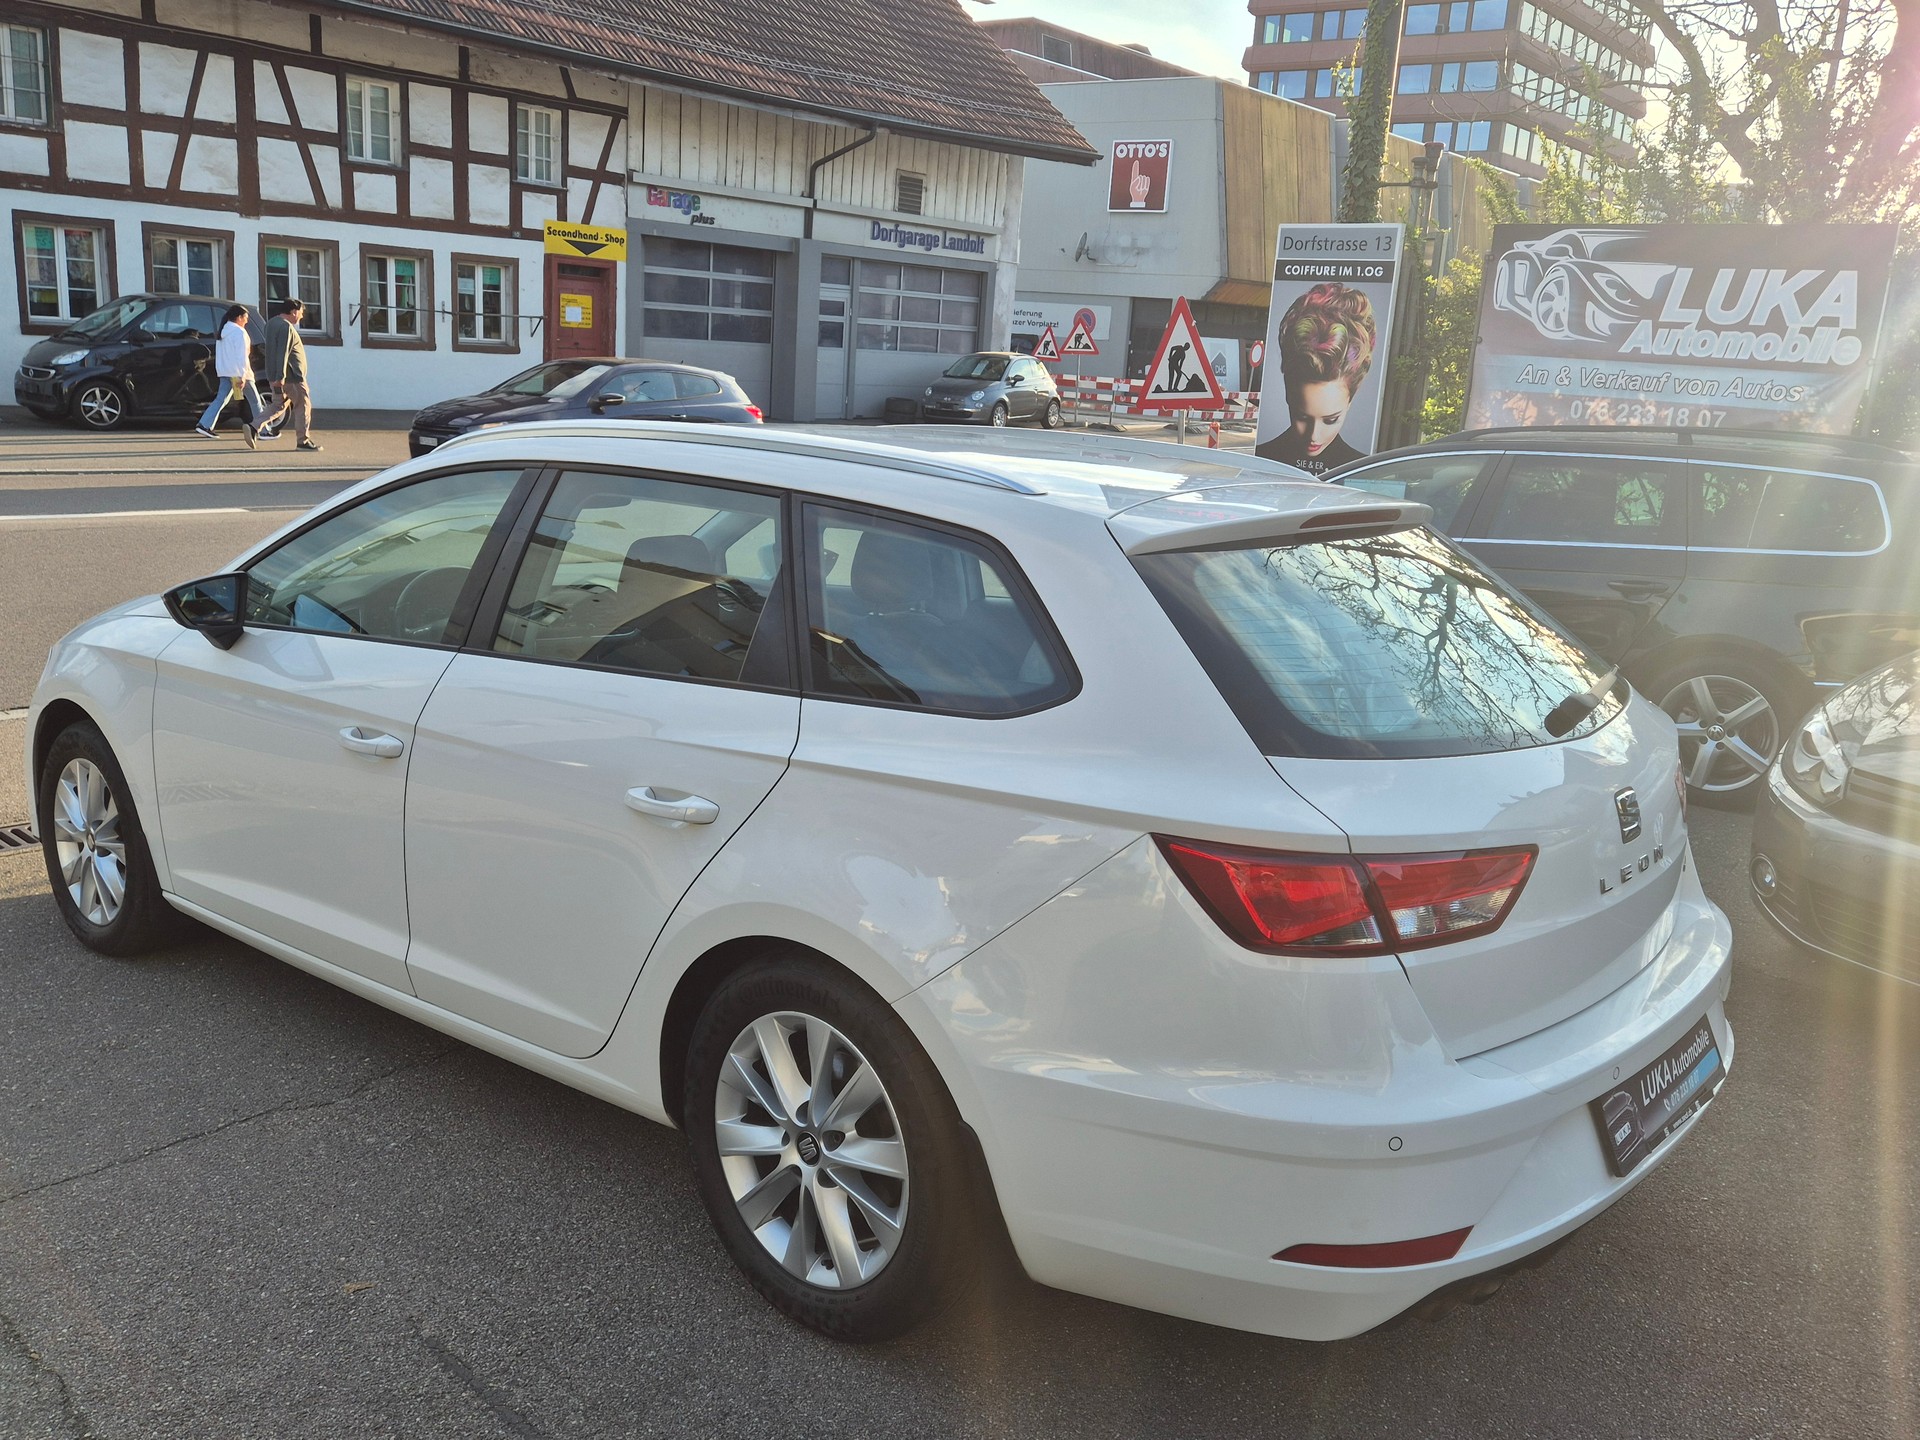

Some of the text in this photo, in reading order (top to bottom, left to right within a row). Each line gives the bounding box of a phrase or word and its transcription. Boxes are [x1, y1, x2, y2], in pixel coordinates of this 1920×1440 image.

[1115, 143, 1168, 158] OTTO'S
[646, 185, 701, 215] Garage
[690, 212, 715, 225] plus
[547, 226, 599, 241] Secondhand
[604, 233, 625, 247] Shop
[870, 220, 985, 254] Dorfgarage Landolt
[1283, 235, 1393, 251] Dorfstrasse 13
[1285, 265, 1384, 277] COIFFURE IM 1.OG
[1659, 268, 1858, 330] LUKA
[1618, 319, 1862, 366] Automobile
[1516, 363, 1805, 402] An & Verkauf von Autos
[1570, 399, 1727, 428] 076 233 18 07
[1295, 459, 1324, 470] SIE & ER
[1600, 843, 1664, 895] LEON
[1640, 1028, 1710, 1107] LUKA Automobile
[1615, 1122, 1632, 1146] LUKA
